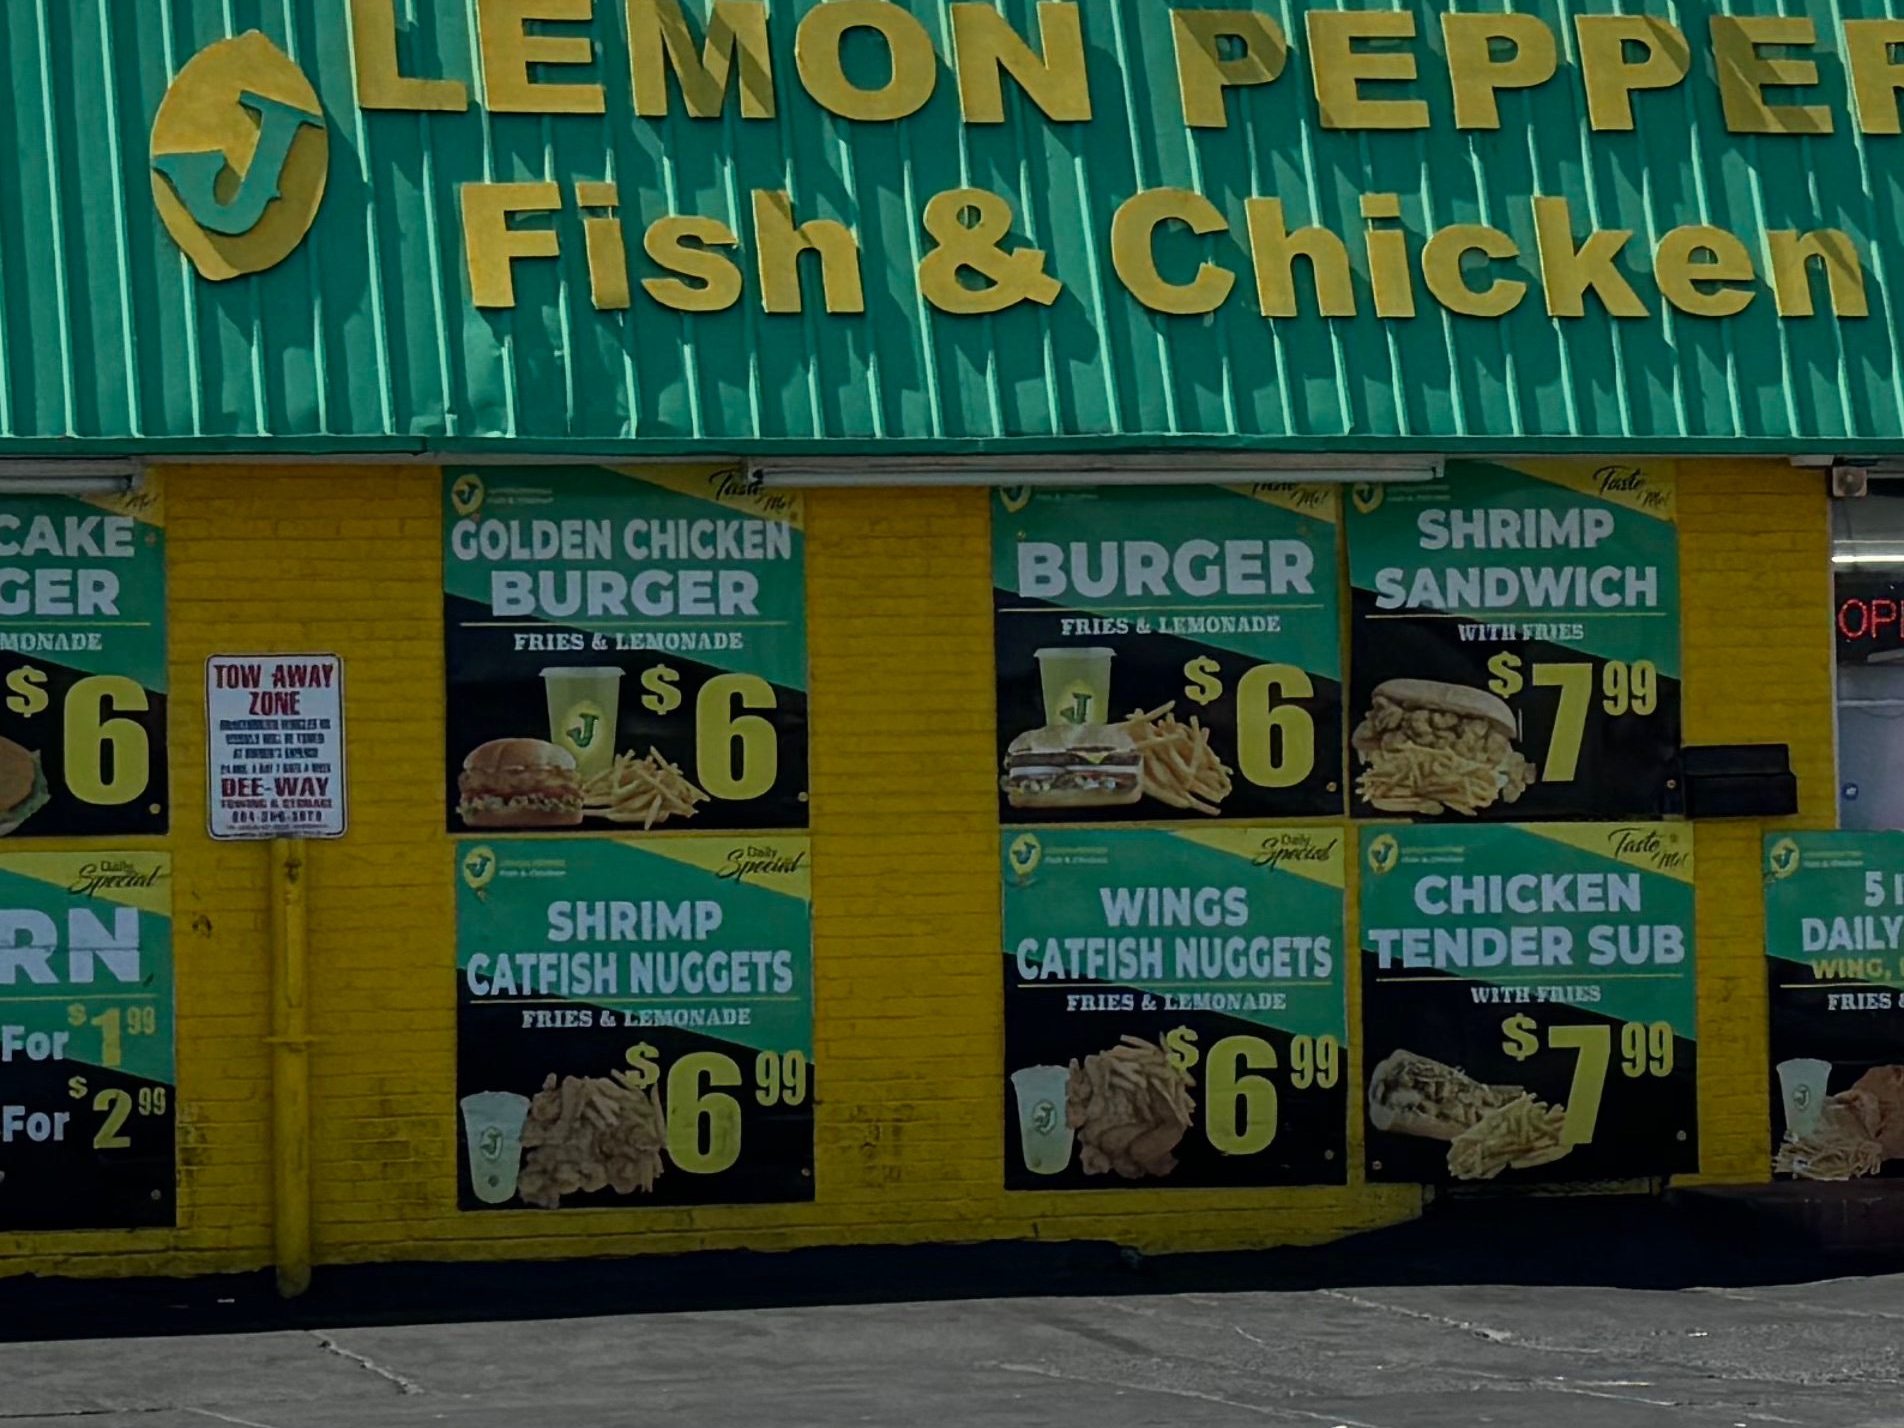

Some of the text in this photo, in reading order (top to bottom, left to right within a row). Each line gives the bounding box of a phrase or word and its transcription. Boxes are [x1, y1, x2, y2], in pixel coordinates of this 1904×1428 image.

[460, 179, 1869, 323] Fish & Chicken
[1593, 465, 1646, 496] Taste
[451, 519, 791, 561] GOLDEN CHICKEN
[1417, 508, 1614, 550] SHRIMP
[1017, 540, 1314, 598] BURGER
[491, 570, 759, 617] BURGER
[1375, 566, 1657, 610] SANDWICH
[514, 633, 743, 651] FRIES & LEMONADE
[1061, 616, 1280, 635] FRIES & LEMONADE
[1458, 624, 1584, 641] WITH FRIES
[249, 691, 300, 715] ZONE
[1251, 837, 1338, 871] Special
[1607, 827, 1661, 857] Taste
[68, 865, 162, 896] Special
[716, 849, 806, 883] Special
[1099, 886, 1248, 927] WINGS
[1414, 873, 1641, 915] CHICKEN
[1865, 872, 1884, 908] 5
[547, 901, 723, 942] SHRIMP
[1801, 915, 1904, 952] DAILY
[1016, 936, 1333, 981] CATFISH NUGGETS
[1369, 925, 1685, 969] TENDER SUB
[466, 950, 792, 996] CATFISH NUGGETS
[1812, 958, 1892, 981] WING,
[1067, 993, 1286, 1011] FRIES & LEMONADE
[1471, 986, 1601, 1004] WITH FRIES
[1827, 993, 1892, 1011] FRIES
[522, 1009, 751, 1029] FRIES & LEMONADE
[1, 1025, 70, 1062] For
[3, 1106, 70, 1142] For
